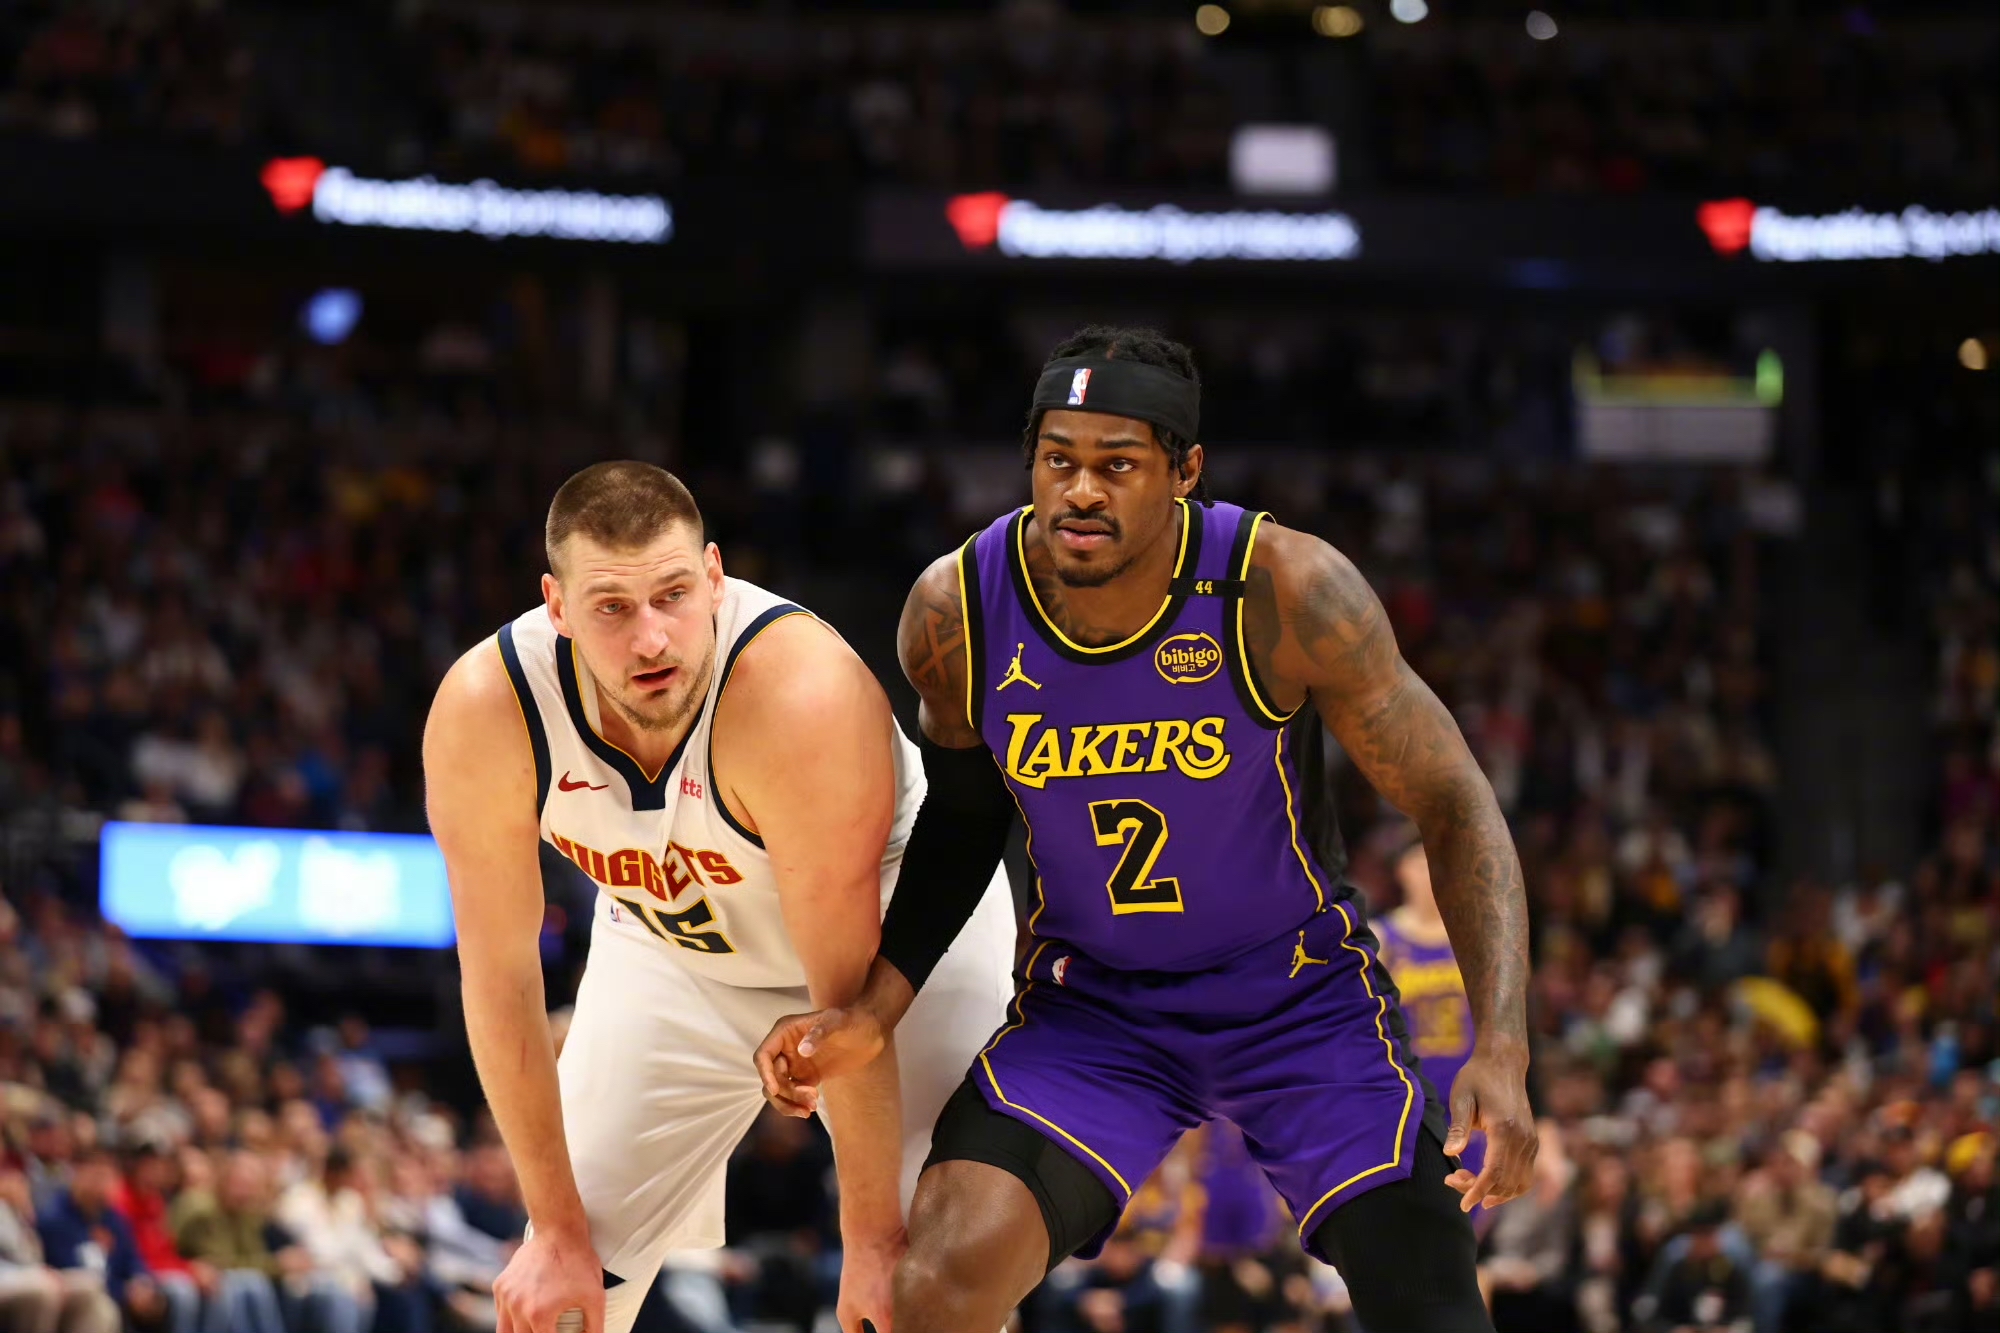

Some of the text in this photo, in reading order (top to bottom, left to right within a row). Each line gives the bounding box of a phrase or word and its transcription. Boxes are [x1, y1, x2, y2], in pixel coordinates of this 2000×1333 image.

[1195, 581, 1213, 594] 44
[1161, 647, 1218, 668] bibigo
[1004, 713, 1232, 790] LAKERS
[680, 776, 702, 800] tta
[1088, 799, 1184, 916] 2
[612, 894, 738, 954] 15
